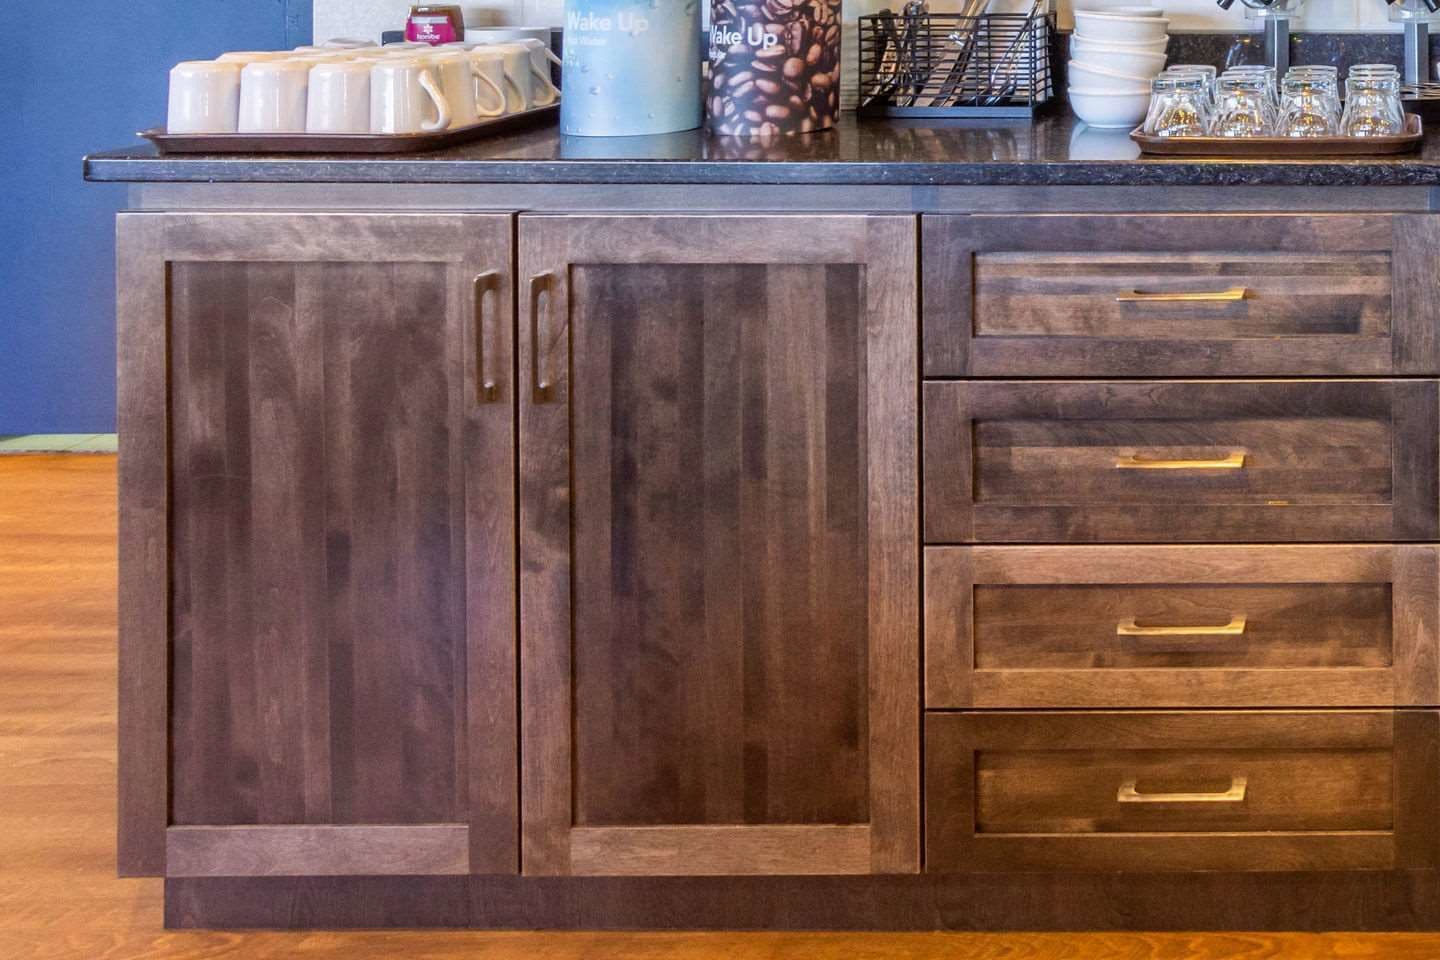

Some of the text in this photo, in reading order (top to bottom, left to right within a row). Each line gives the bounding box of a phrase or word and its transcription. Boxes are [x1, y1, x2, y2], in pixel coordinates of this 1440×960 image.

[567, 10, 649, 38] Wake Up
[747, 26, 779, 50] Up
